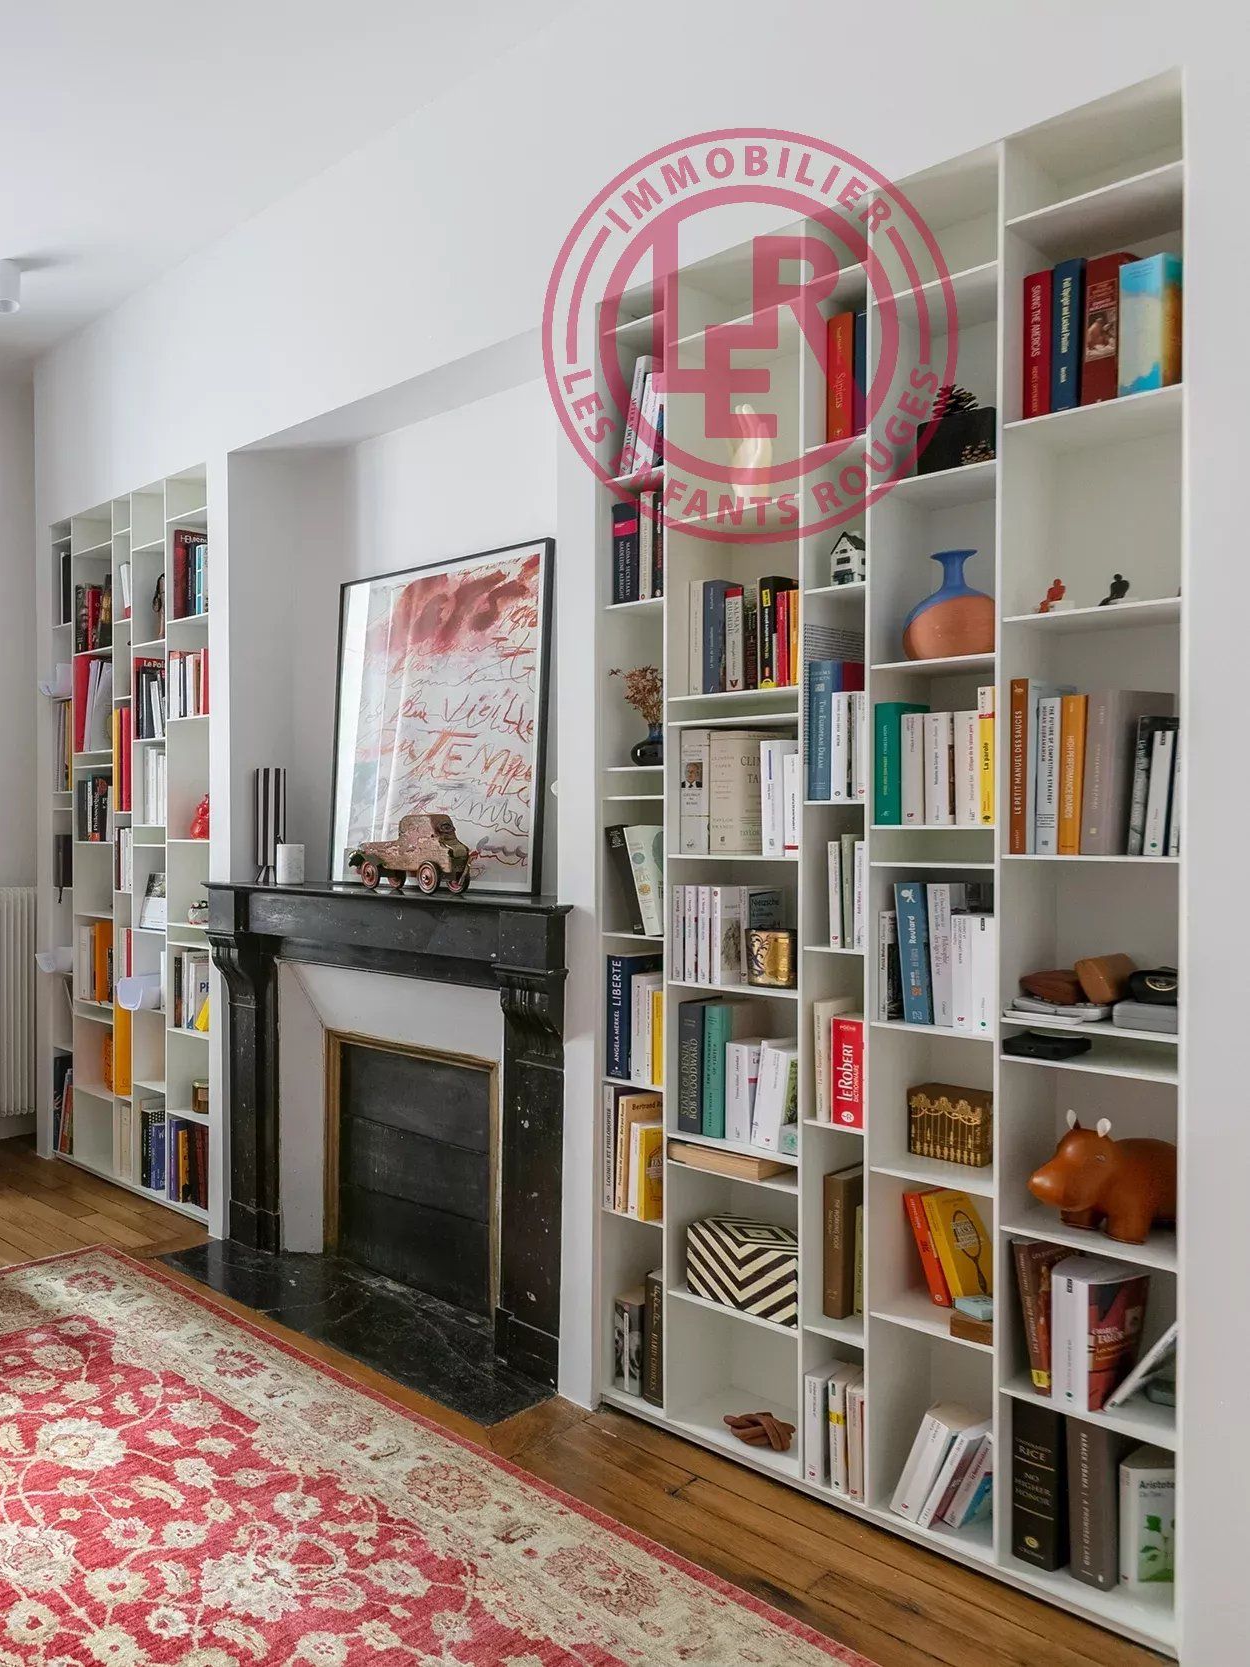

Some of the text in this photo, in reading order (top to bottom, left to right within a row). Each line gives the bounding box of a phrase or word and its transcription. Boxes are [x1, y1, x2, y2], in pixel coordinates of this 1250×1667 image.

[1030, 310, 1041, 322] THE
[833, 372, 846, 408] Sapiens
[818, 747, 826, 769] DREAM
[1014, 710, 1022, 815] LE PETIT MANUEL DES SAUCES
[1065, 750, 1075, 795] PERFORMANCE
[907, 915, 917, 944] Routard
[681, 1040, 689, 1074] DENIAL
[689, 1038, 698, 1120] BOB WOODWARD
[631, 1101, 656, 1110] Bertrand
[1019, 1446, 1047, 1462] RICE
[1080, 1432, 1090, 1488] BARACK OBAMA
[1024, 1472, 1040, 1481] NO
[1082, 1506, 1090, 1544] PROMISED
